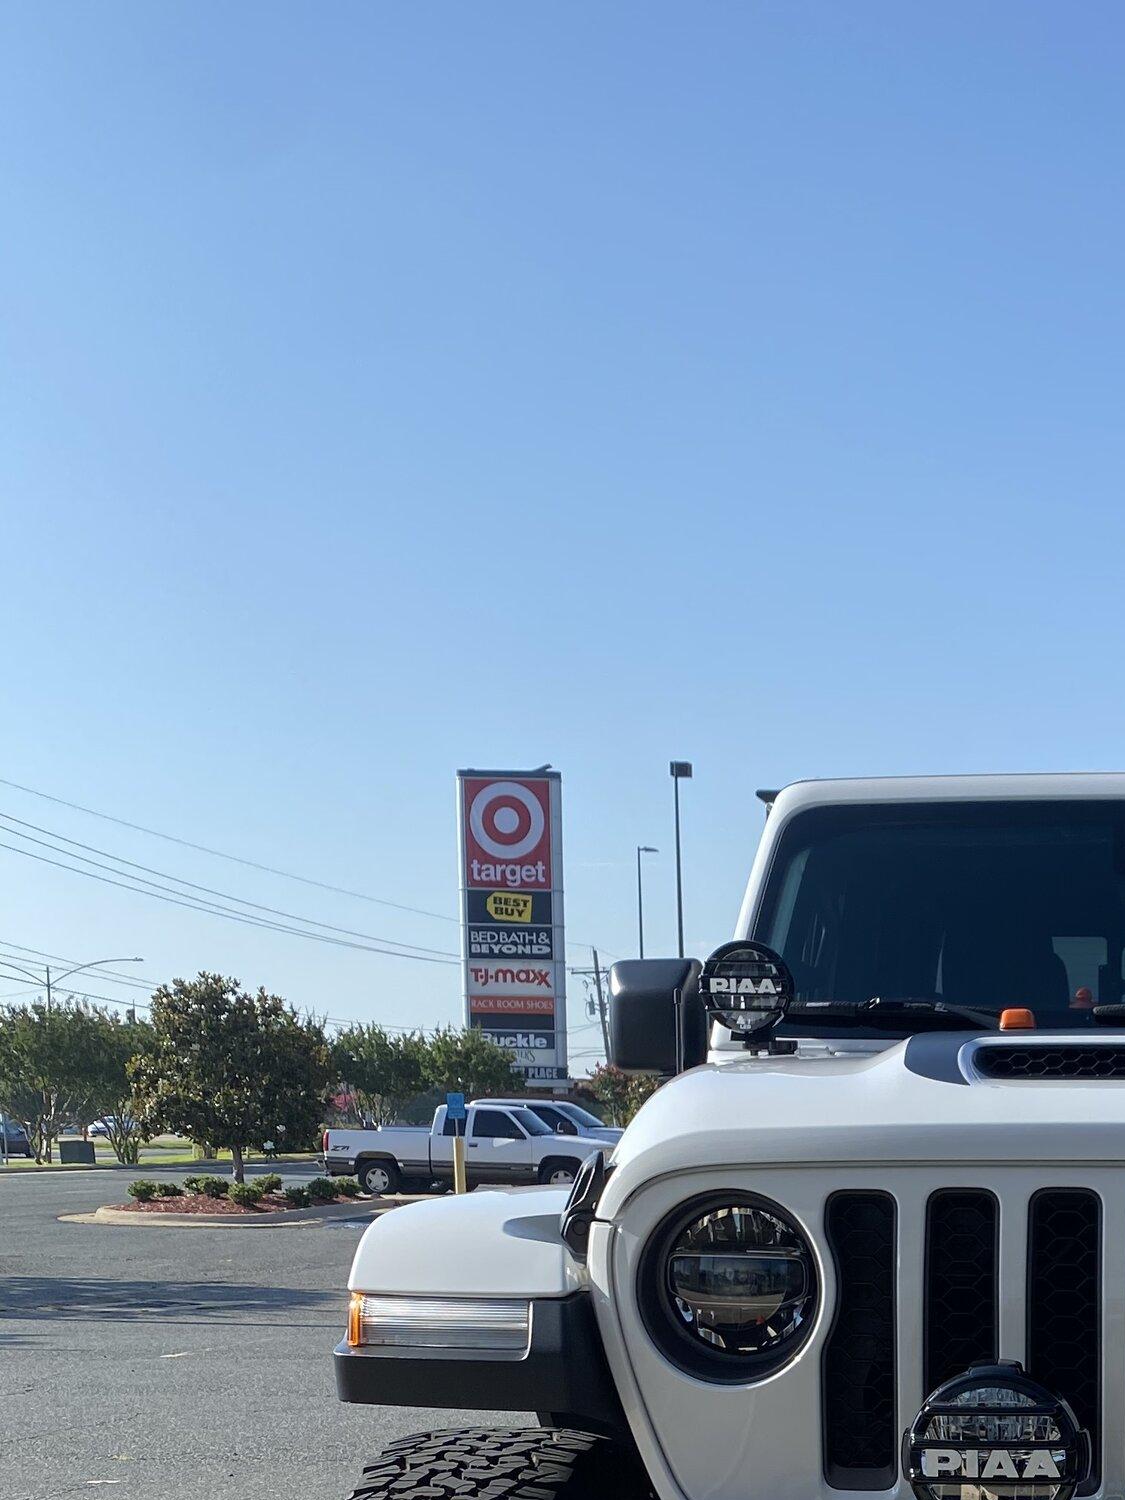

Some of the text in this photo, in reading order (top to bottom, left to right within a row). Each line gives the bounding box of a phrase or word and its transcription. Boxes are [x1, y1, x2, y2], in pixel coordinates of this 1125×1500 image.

[470, 859, 546, 887] target
[493, 896, 530, 908] BEST
[494, 906, 526, 918] BUY
[470, 931, 551, 945] BED BATH &
[470, 943, 551, 955] BEYOND
[709, 977, 777, 994] PIAA
[497, 999, 524, 1009] ROOM
[526, 1000, 553, 1010] SHOES
[528, 1067, 558, 1079] PLACE
[923, 1449, 1061, 1478] PIAA
